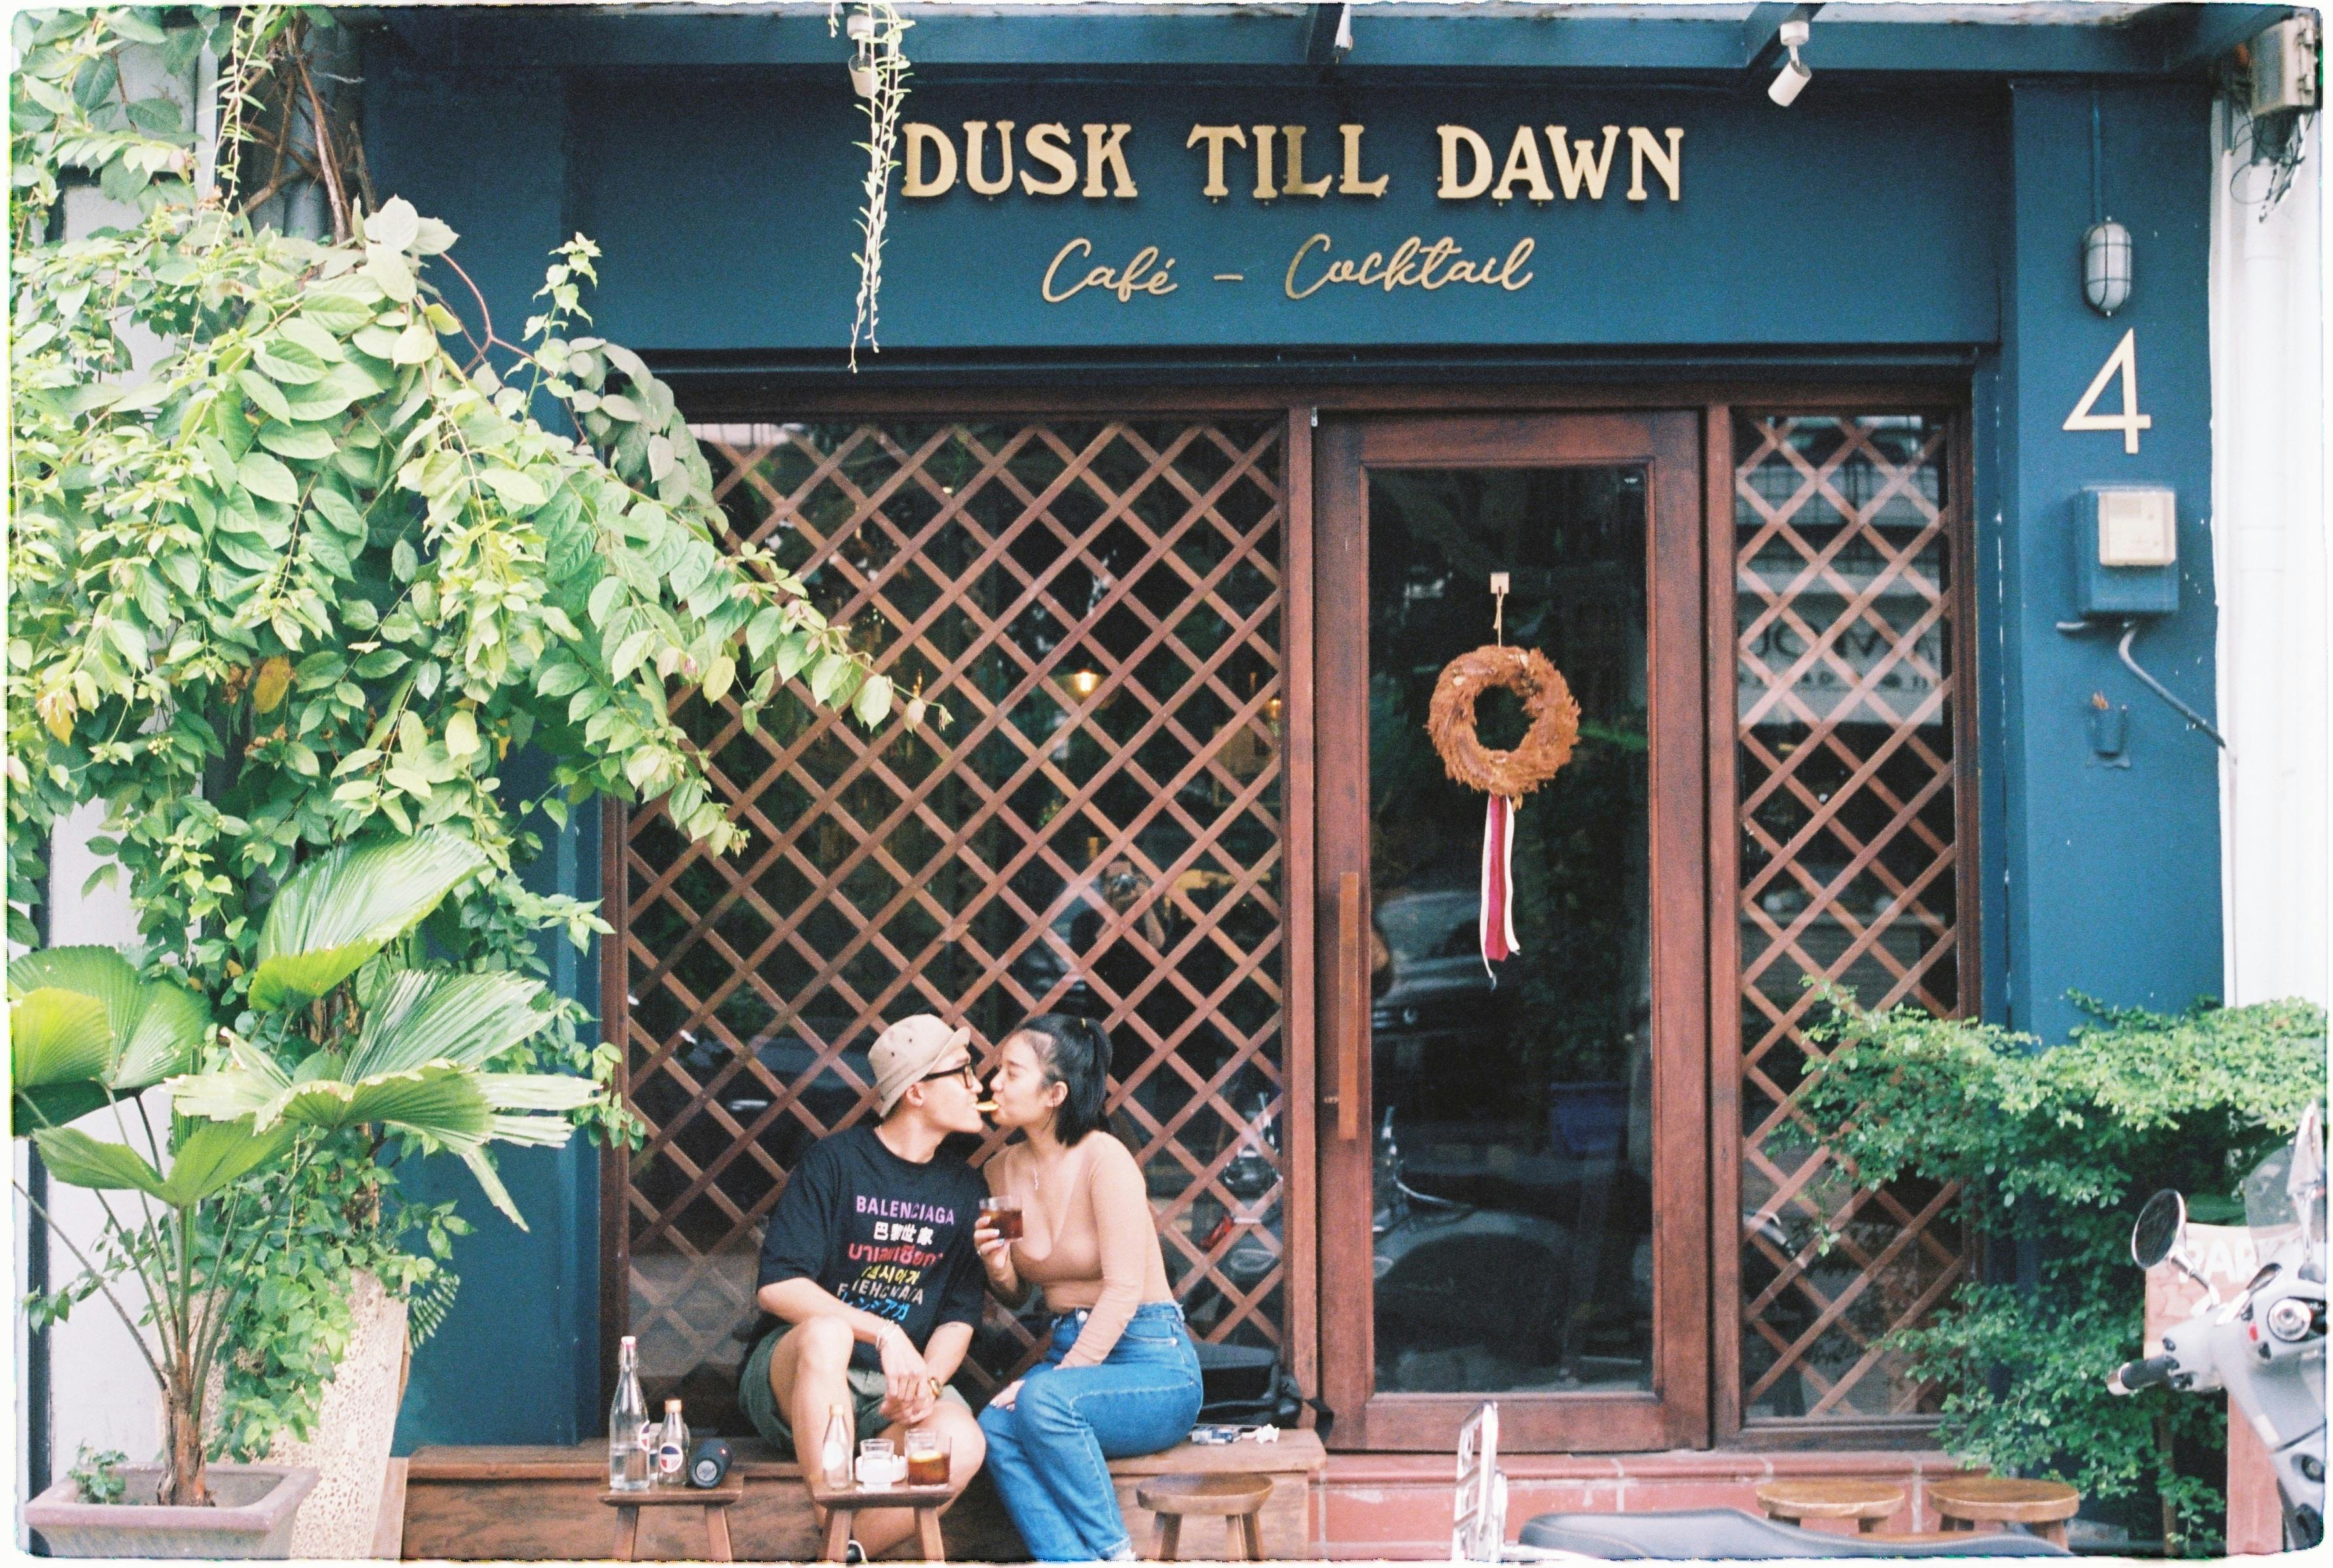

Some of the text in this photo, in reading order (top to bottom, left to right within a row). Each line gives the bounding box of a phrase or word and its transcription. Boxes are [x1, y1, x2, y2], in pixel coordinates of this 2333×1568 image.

[901, 120, 1685, 200] DUSK TILL DAWN
[1042, 237, 1176, 303] Café
[1285, 233, 1535, 300] Cocktail
[2062, 327, 2151, 453] 4
[856, 1195, 955, 1225] BALENCIAGA
[873, 1221, 934, 1246] 巴黎世家
